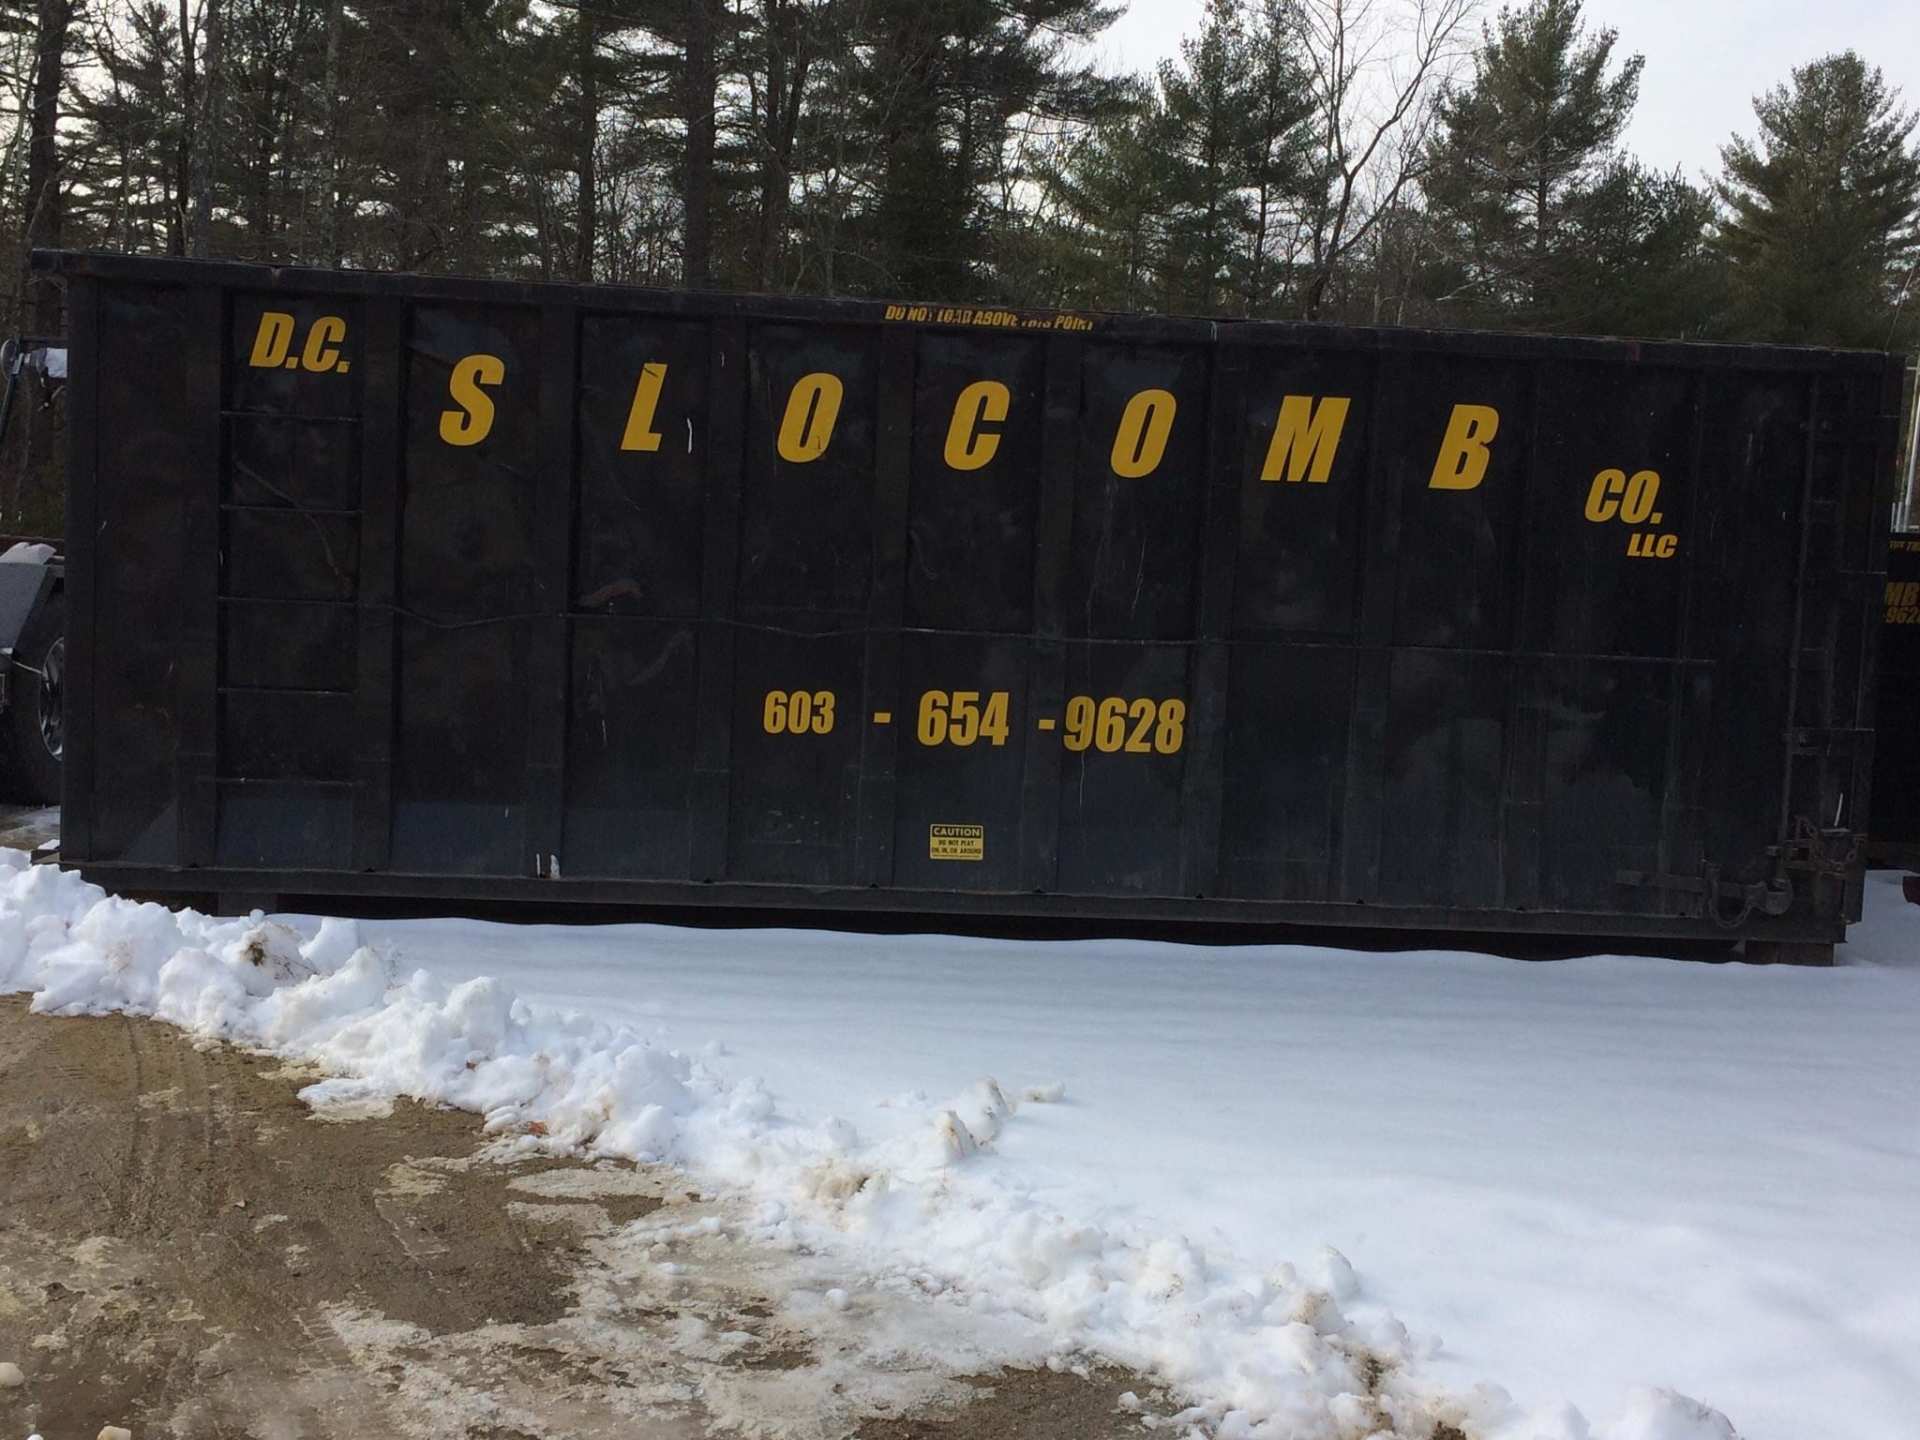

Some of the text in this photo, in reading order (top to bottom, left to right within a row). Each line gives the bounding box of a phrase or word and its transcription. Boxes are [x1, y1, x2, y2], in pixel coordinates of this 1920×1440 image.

[884, 305, 906, 321] DO
[972, 311, 1018, 327] ABOVE
[249, 312, 351, 373] D.C.
[1584, 469, 1662, 525] CO.
[1626, 533, 1678, 559] LLC
[763, 690, 835, 734] 603
[917, 690, 1009, 746] 654
[1064, 696, 1185, 754] 9628
[934, 827, 981, 837] CAUTION
